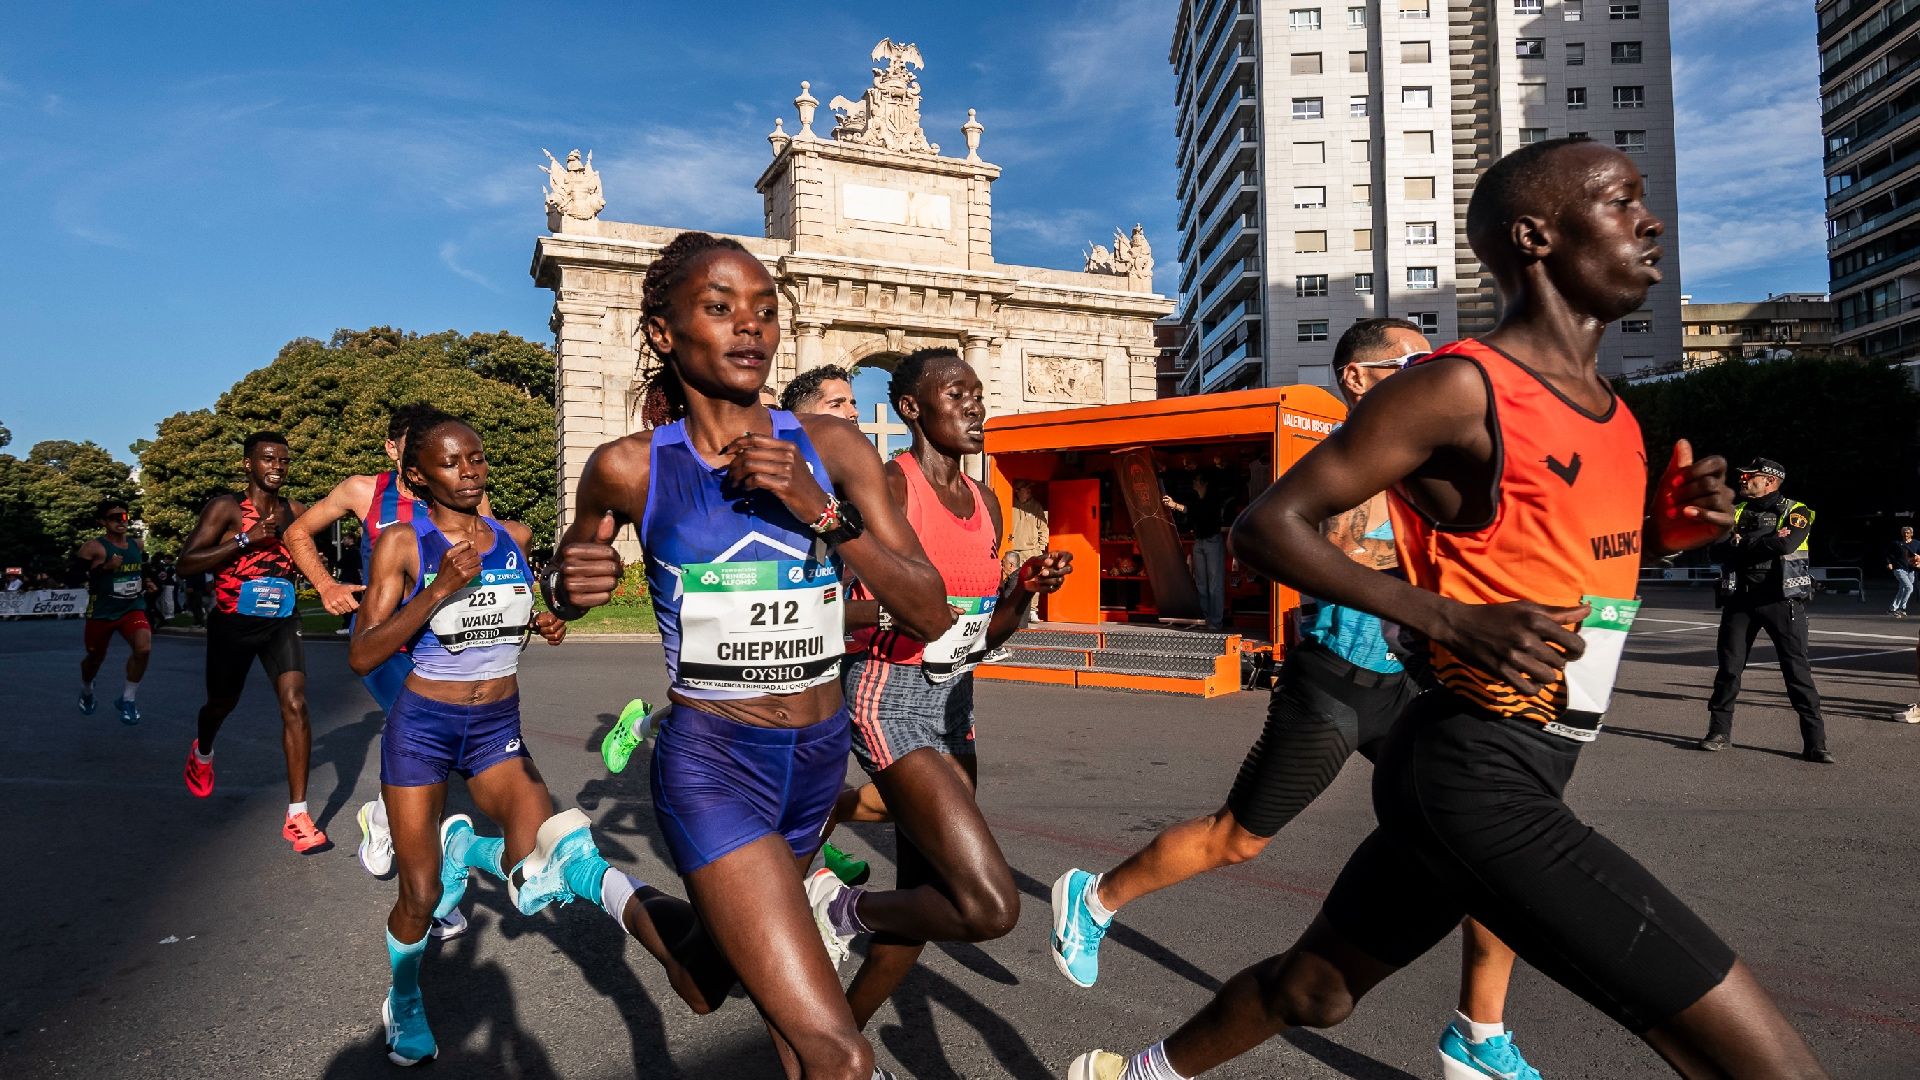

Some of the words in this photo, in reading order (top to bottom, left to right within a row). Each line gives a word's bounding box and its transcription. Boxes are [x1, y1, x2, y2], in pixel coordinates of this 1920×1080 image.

[1282, 413, 1311, 431] VALENCIA
[1590, 530, 1640, 560] VALENC
[808, 566, 836, 578] ZURIC
[32, 602, 74, 613] Esfuerzo
[468, 591, 497, 608] 223
[461, 612, 504, 628] WANZA
[750, 600, 799, 626] 212
[464, 628, 500, 640] OYSHO
[717, 635, 824, 661] CHEPKIRUI
[742, 665, 804, 681] OYSHO
